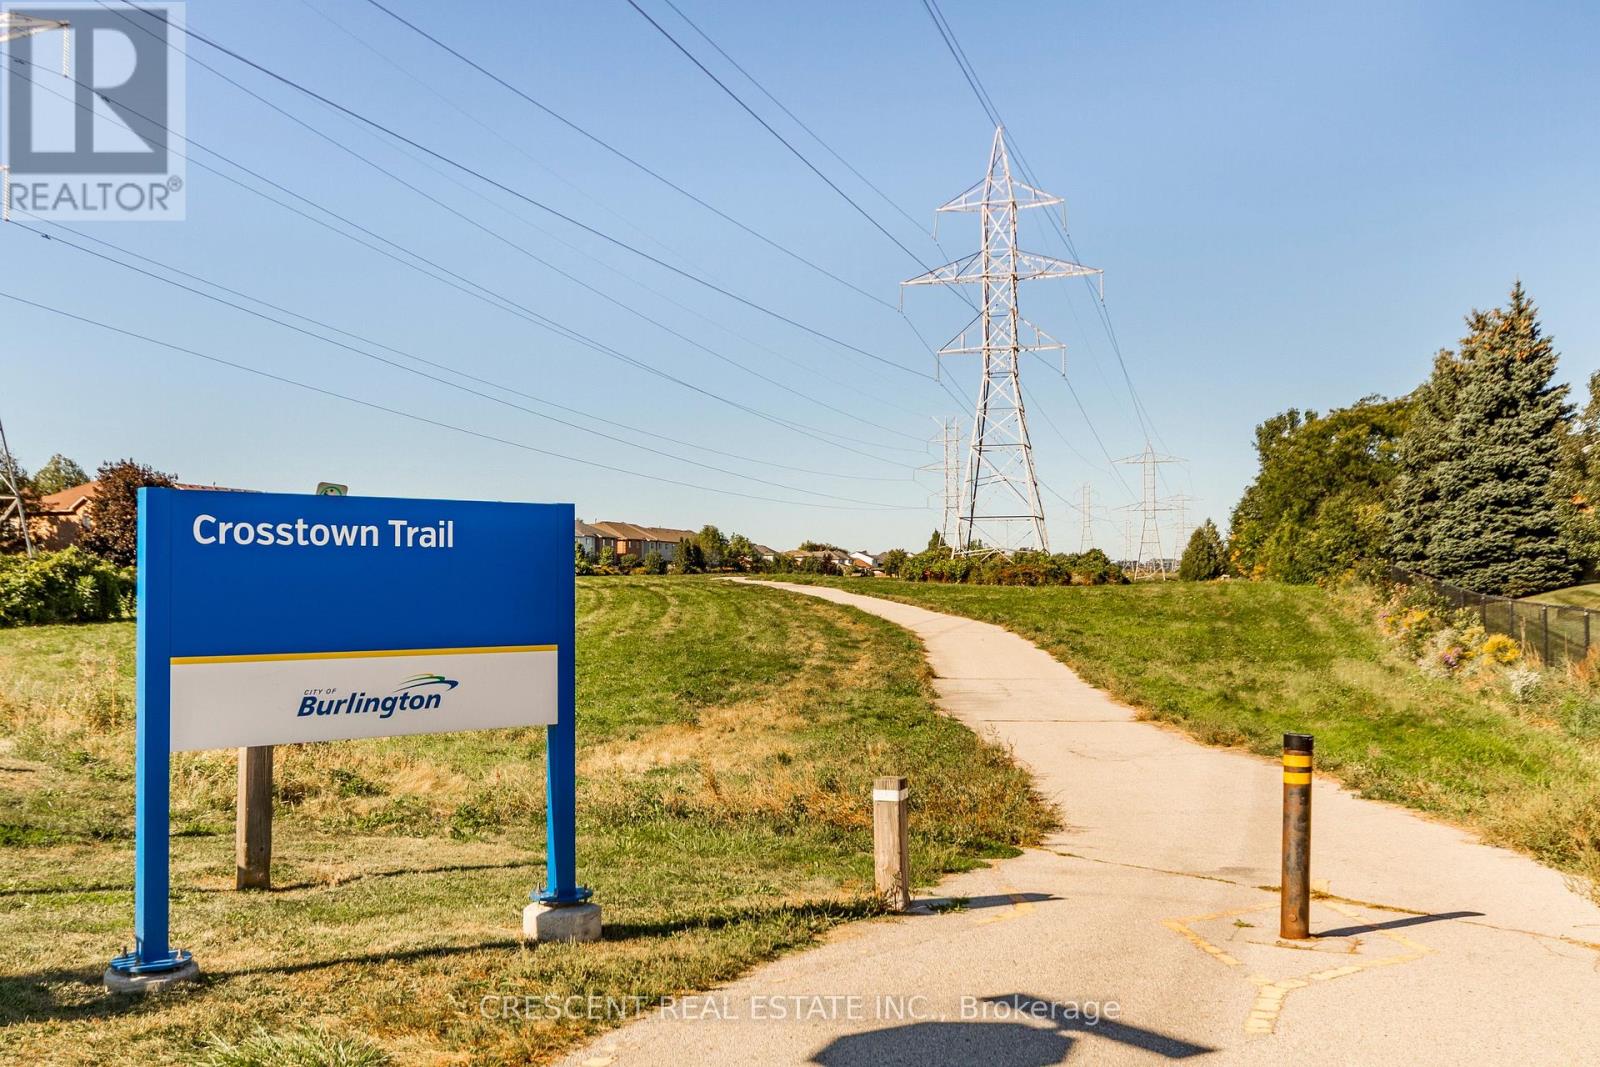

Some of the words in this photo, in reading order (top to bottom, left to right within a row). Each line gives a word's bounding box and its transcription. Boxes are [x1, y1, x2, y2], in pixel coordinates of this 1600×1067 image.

[192, 514, 379, 547] Crosstown
[388, 519, 454, 548] Trail
[297, 692, 441, 719] Burlington
